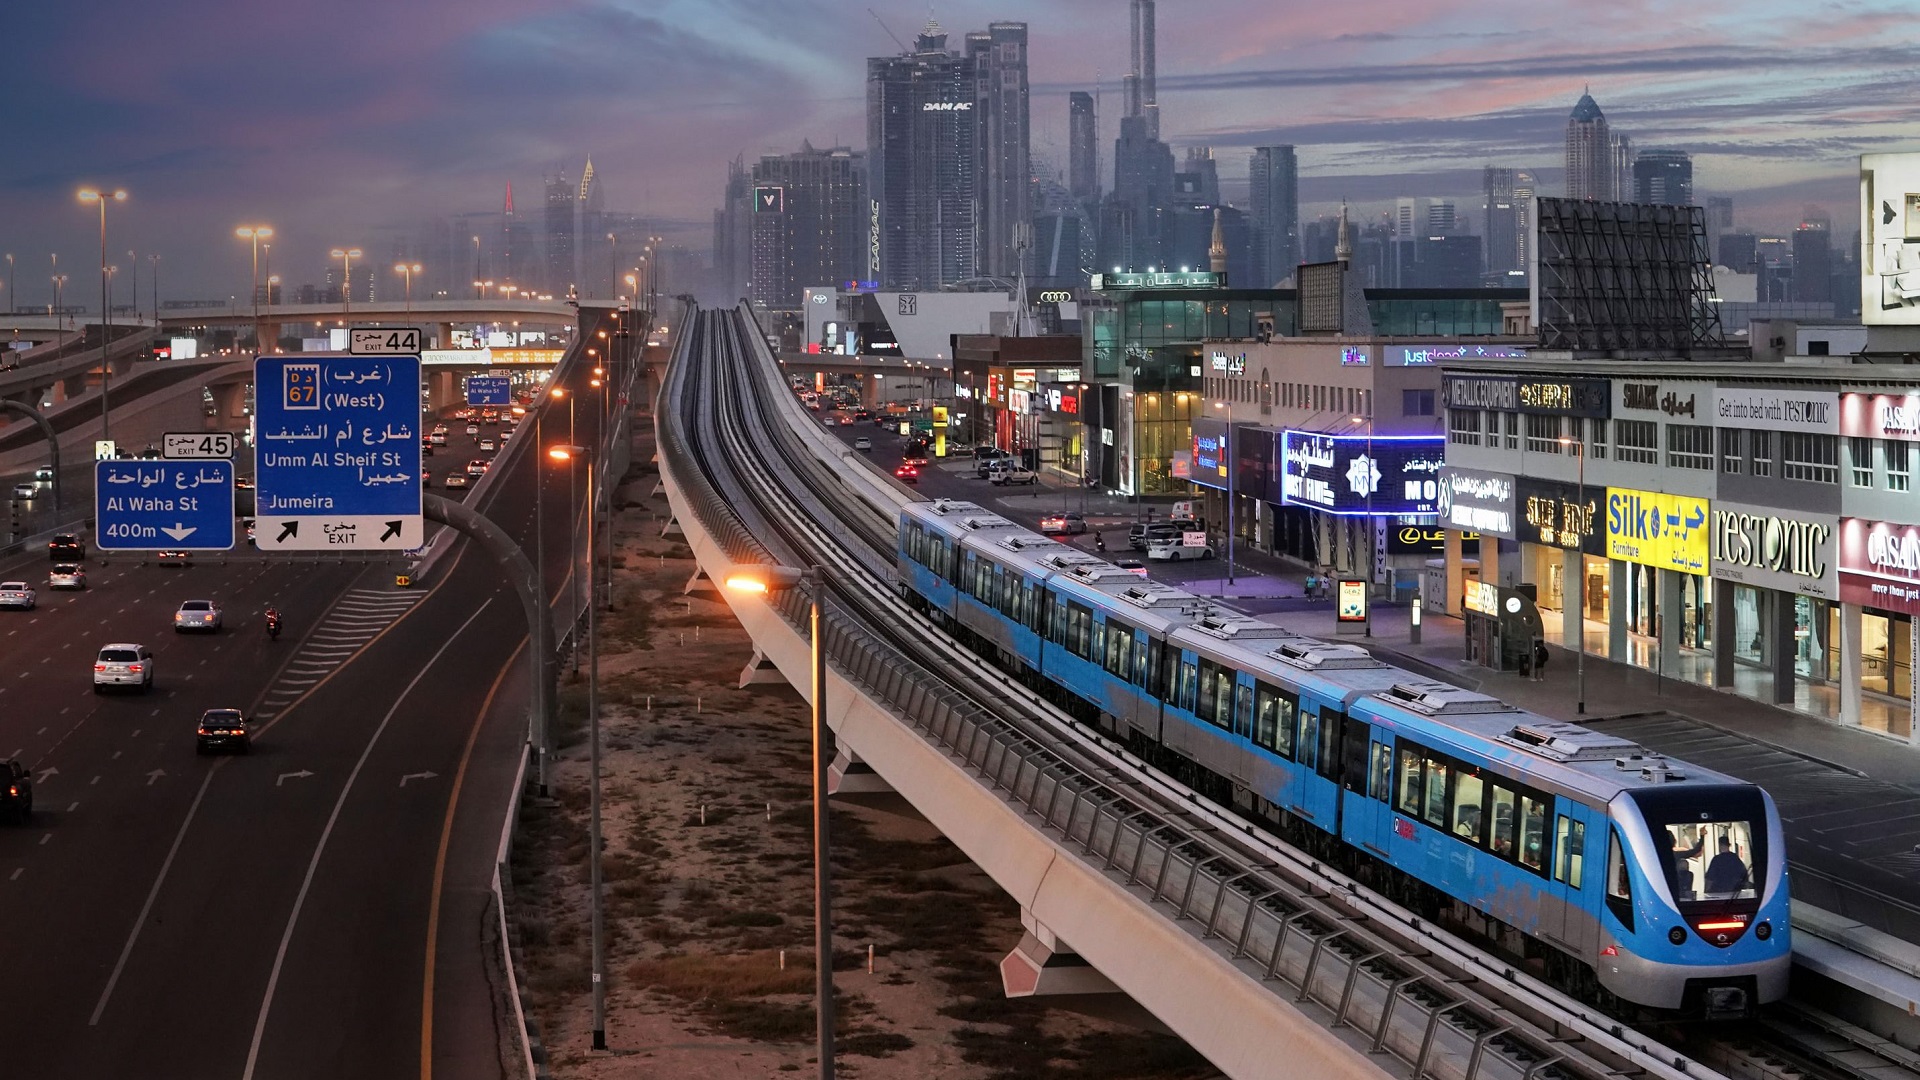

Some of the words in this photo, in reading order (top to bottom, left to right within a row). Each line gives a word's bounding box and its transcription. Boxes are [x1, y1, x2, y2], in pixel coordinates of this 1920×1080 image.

[923, 103, 972, 111] DAMAC
[355, 334, 382, 342] مخرج
[386, 333, 416, 350] 44
[291, 373, 300, 383] D
[289, 386, 314, 402] 67
[324, 393, 385, 411] (West)
[1480, 379, 1517, 410] EQUIPMENT
[1719, 398, 1732, 417] Get
[1733, 400, 1748, 419] into
[1749, 397, 1763, 419] bed
[1764, 398, 1781, 420] with
[168, 437, 194, 446] مخرج
[265, 423, 328, 443] الشيف
[335, 419, 352, 448] أم
[362, 423, 411, 445] شارع
[198, 437, 228, 454] 45
[264, 453, 306, 467] Umm
[312, 453, 329, 466] Al
[334, 453, 377, 466] Sheif
[382, 453, 401, 466] St
[107, 468, 165, 488] الواحة
[175, 468, 224, 489] شارع
[359, 467, 411, 486] جميرا
[107, 497, 123, 511] Al
[129, 497, 174, 511] Waha
[179, 497, 198, 511] St
[269, 494, 334, 509] Jumeira
[1609, 494, 1648, 541] Silk
[1663, 503, 1705, 541] حرير
[107, 524, 156, 537] 400m
[323, 522, 356, 533] مخرج
[329, 534, 356, 544] EXIT
[1612, 540, 1639, 558] Furniture
[1871, 583, 1888, 595] more
[1889, 585, 1905, 597] than
[1906, 587, 1919, 603] just
